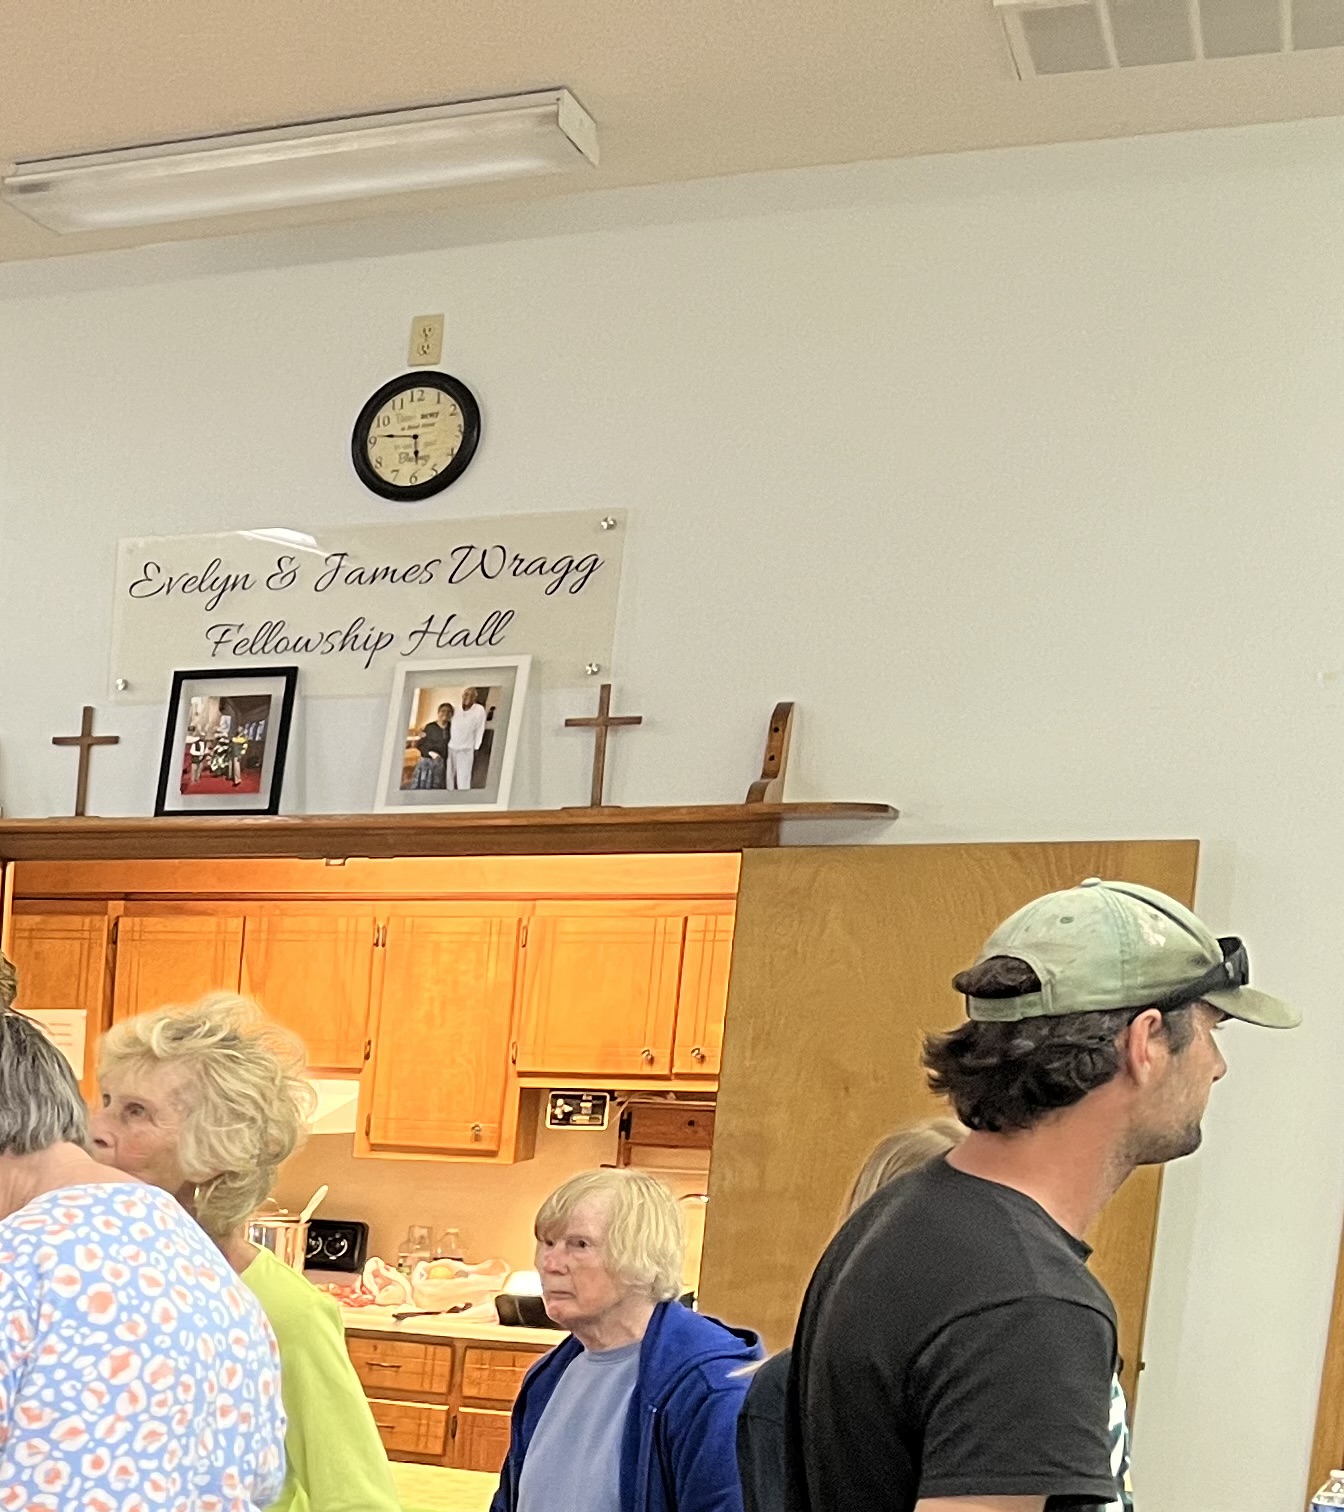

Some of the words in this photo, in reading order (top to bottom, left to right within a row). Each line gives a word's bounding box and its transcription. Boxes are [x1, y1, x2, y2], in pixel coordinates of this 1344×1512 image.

[410, 389, 425, 403] 12
[436, 391, 441, 405] 1
[392, 397, 404, 411] 11
[448, 403, 458, 417] 2
[376, 415, 391, 429] 10
[368, 436, 377, 449] 9
[374, 456, 383, 469] 8
[390, 469, 400, 482] 7
[409, 468, 419, 484] 6
[128, 557, 258, 611] Evelyn
[264, 554, 301, 591] &
[313, 550, 443, 593] James
[447, 543, 607, 596] Wragg
[204, 615, 396, 669] Fellowship
[399, 608, 516, 657] Hall
